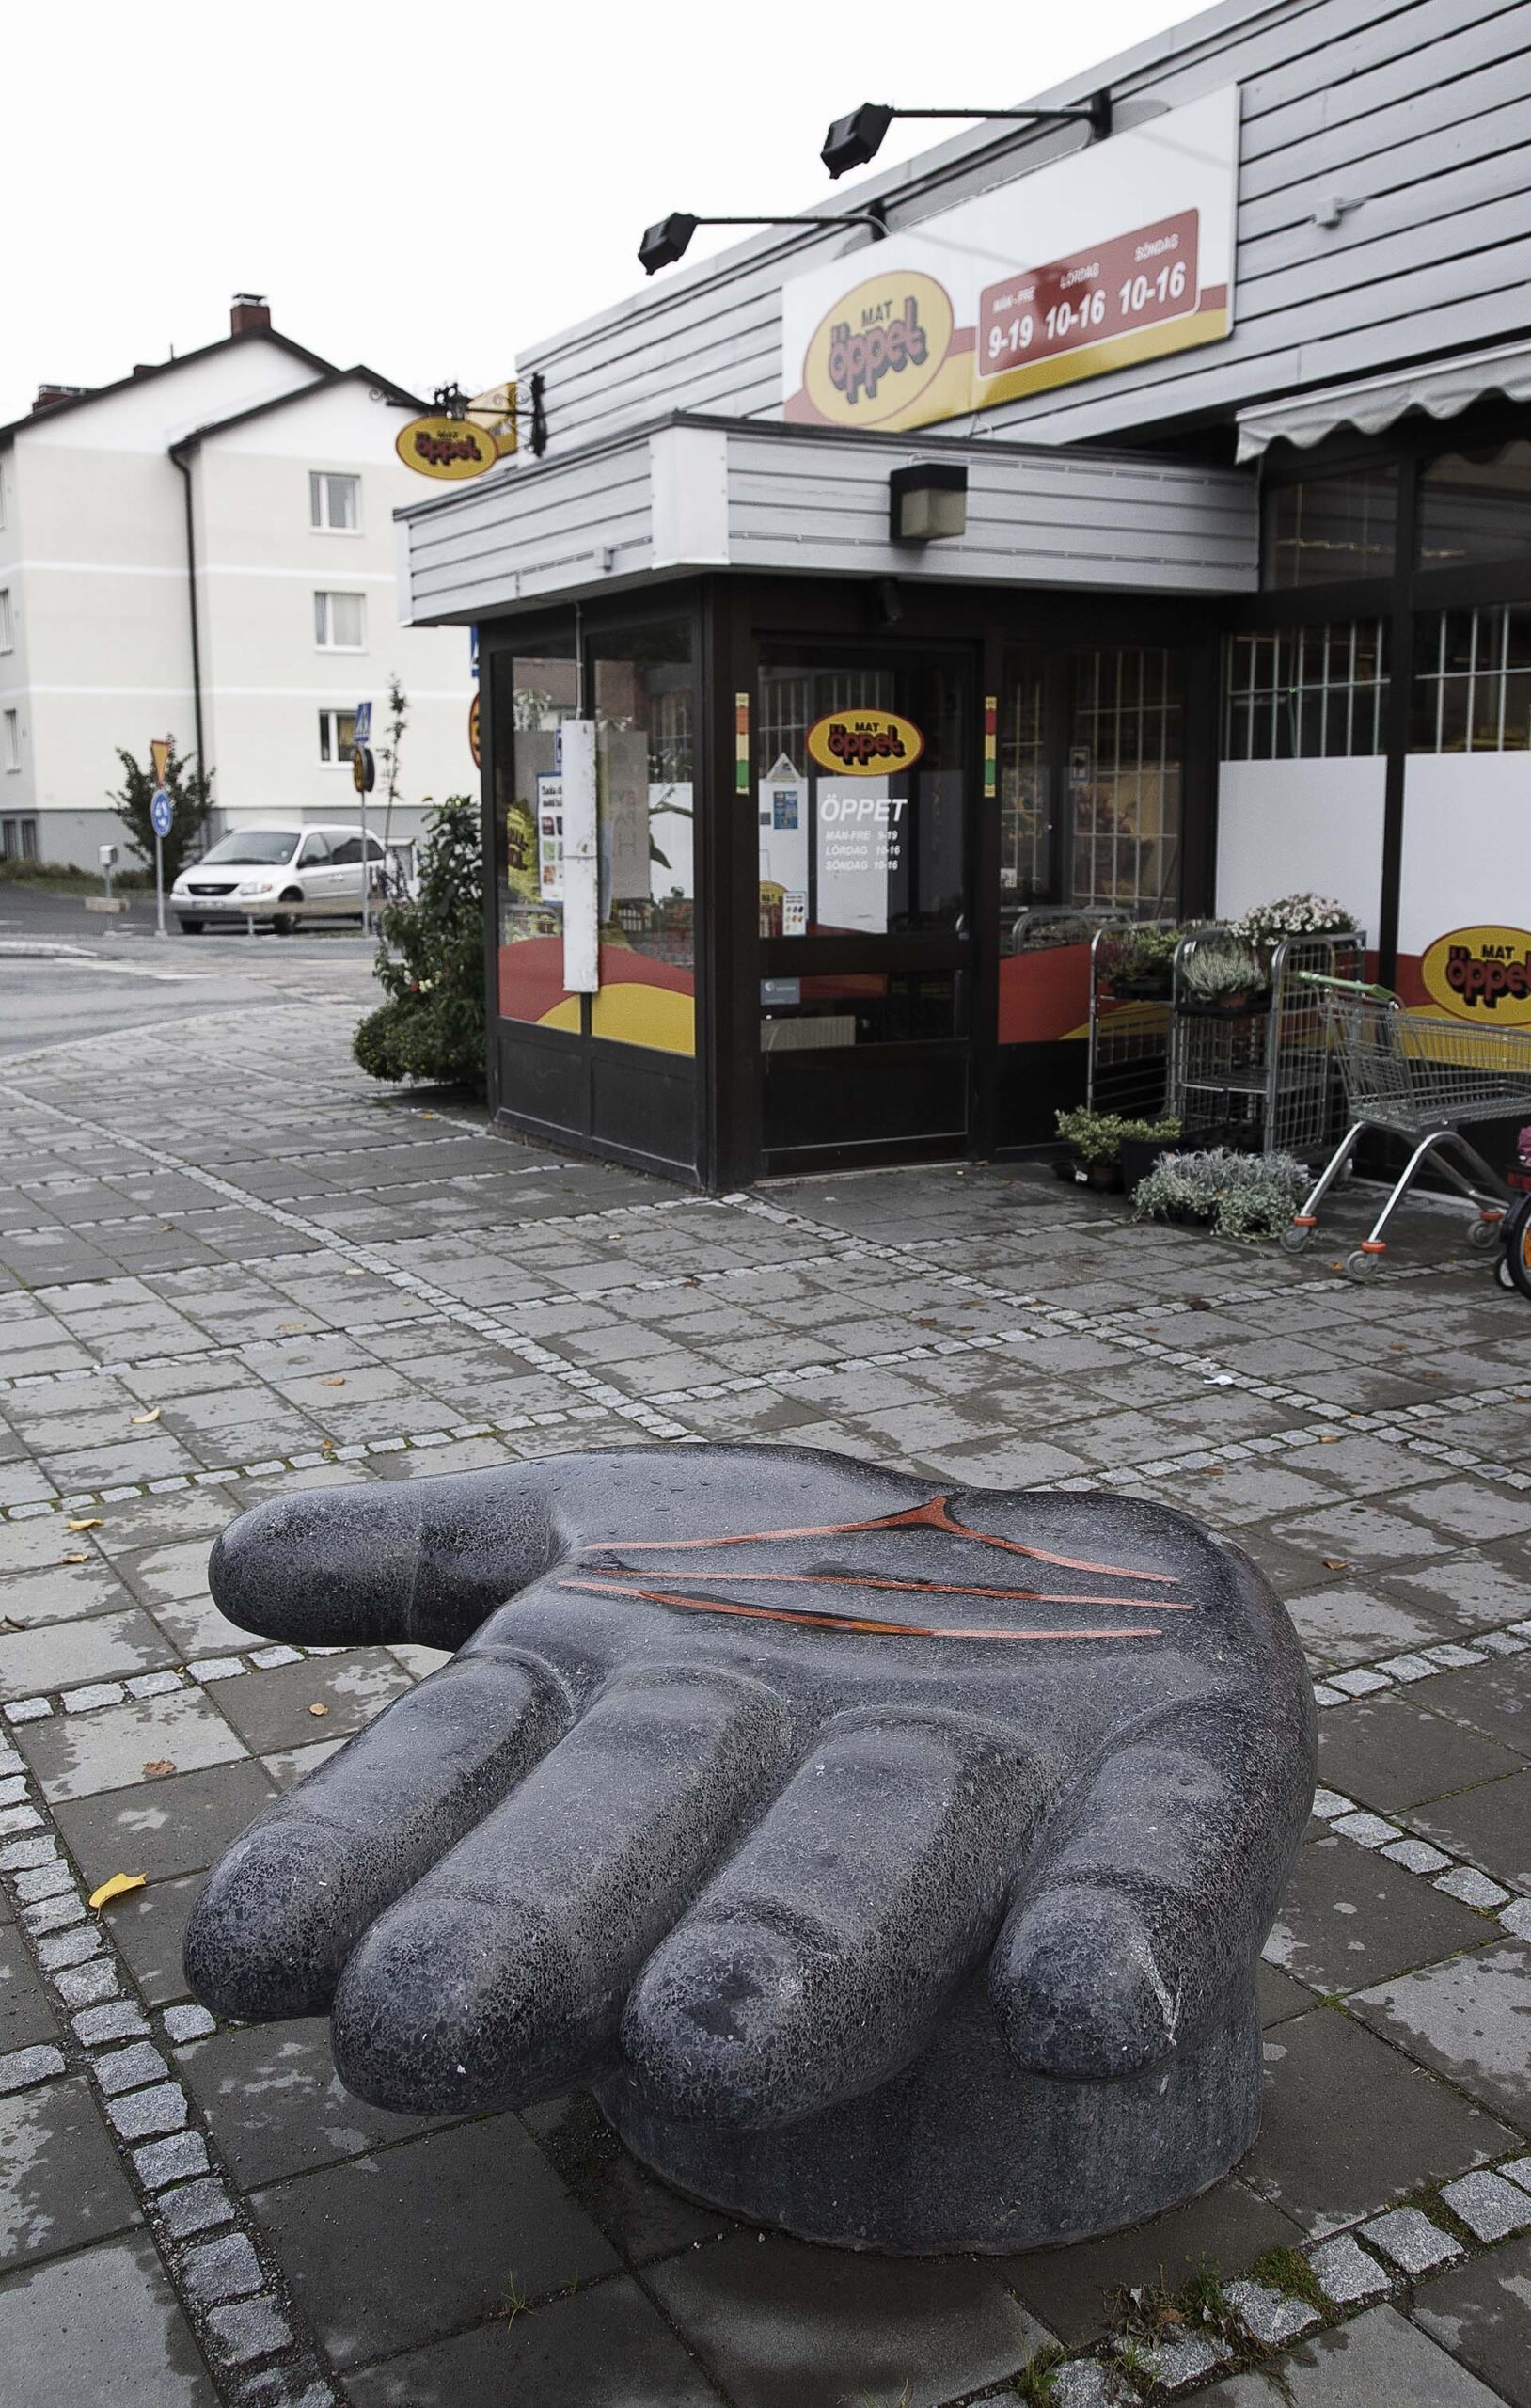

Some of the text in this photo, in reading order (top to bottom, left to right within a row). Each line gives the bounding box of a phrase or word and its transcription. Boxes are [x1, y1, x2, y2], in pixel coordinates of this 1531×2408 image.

[1060, 262, 1100, 290] LÖRDAG
[1134, 233, 1179, 263] SÖNDAG
[861, 300, 892, 327] MAT
[988, 261, 1186, 359] 9-19 10-16 10-16
[855, 722, 879, 732] MAT
[820, 793, 908, 822] ÖPPET
[878, 830, 898, 841] 9-19
[826, 844, 901, 856] LÖRDAG 10-16
[826, 859, 899, 871] SÖNDAG 10-16
[1481, 943, 1516, 959] MAT
